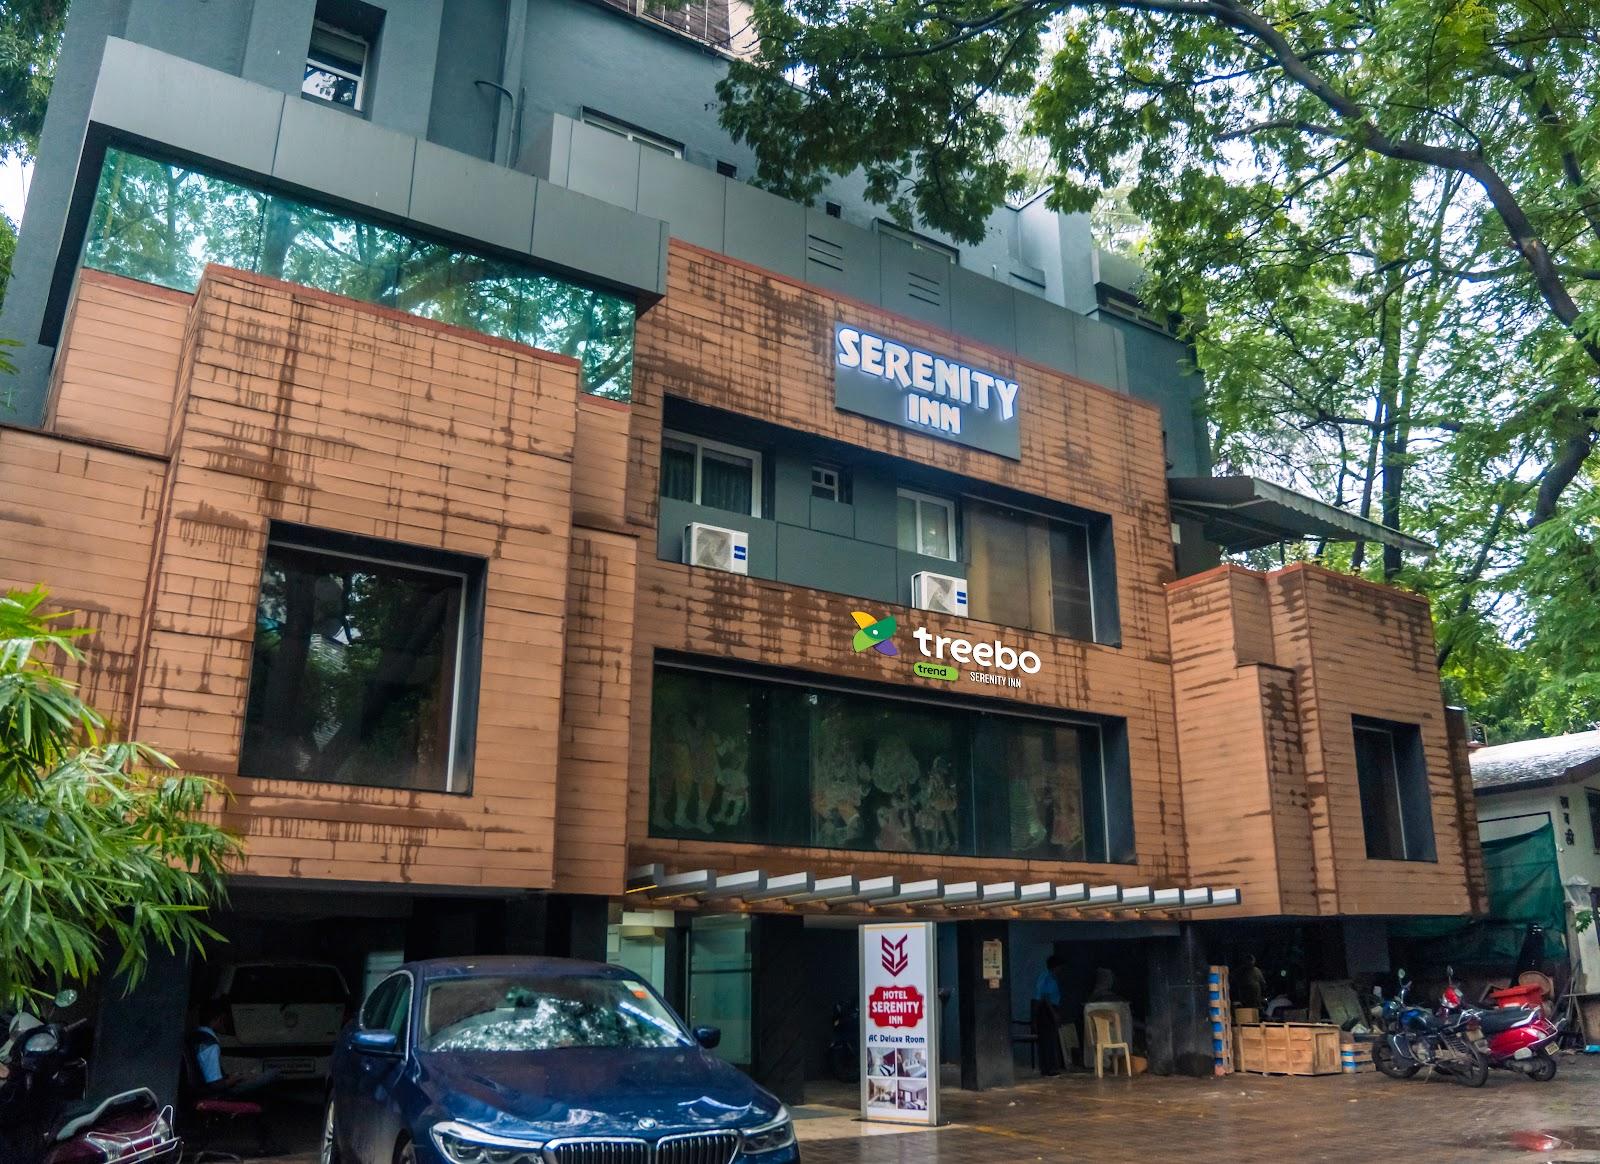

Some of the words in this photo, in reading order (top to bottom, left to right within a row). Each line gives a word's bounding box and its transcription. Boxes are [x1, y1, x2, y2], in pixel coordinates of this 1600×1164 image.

[838, 328, 1019, 421] SERENITY
[908, 393, 961, 435] INN
[913, 626, 1041, 674] treebo
[917, 664, 947, 677] trend
[970, 671, 1007, 687] SERENITY
[1008, 677, 1021, 688] INN
[882, 990, 908, 1000] HOTEL
[871, 1001, 920, 1014] SERENITY
[888, 1015, 903, 1025] INN
[868, 1034, 878, 1042] AC
[880, 1034, 903, 1043] Deluxe
[905, 1035, 925, 1044] Room
